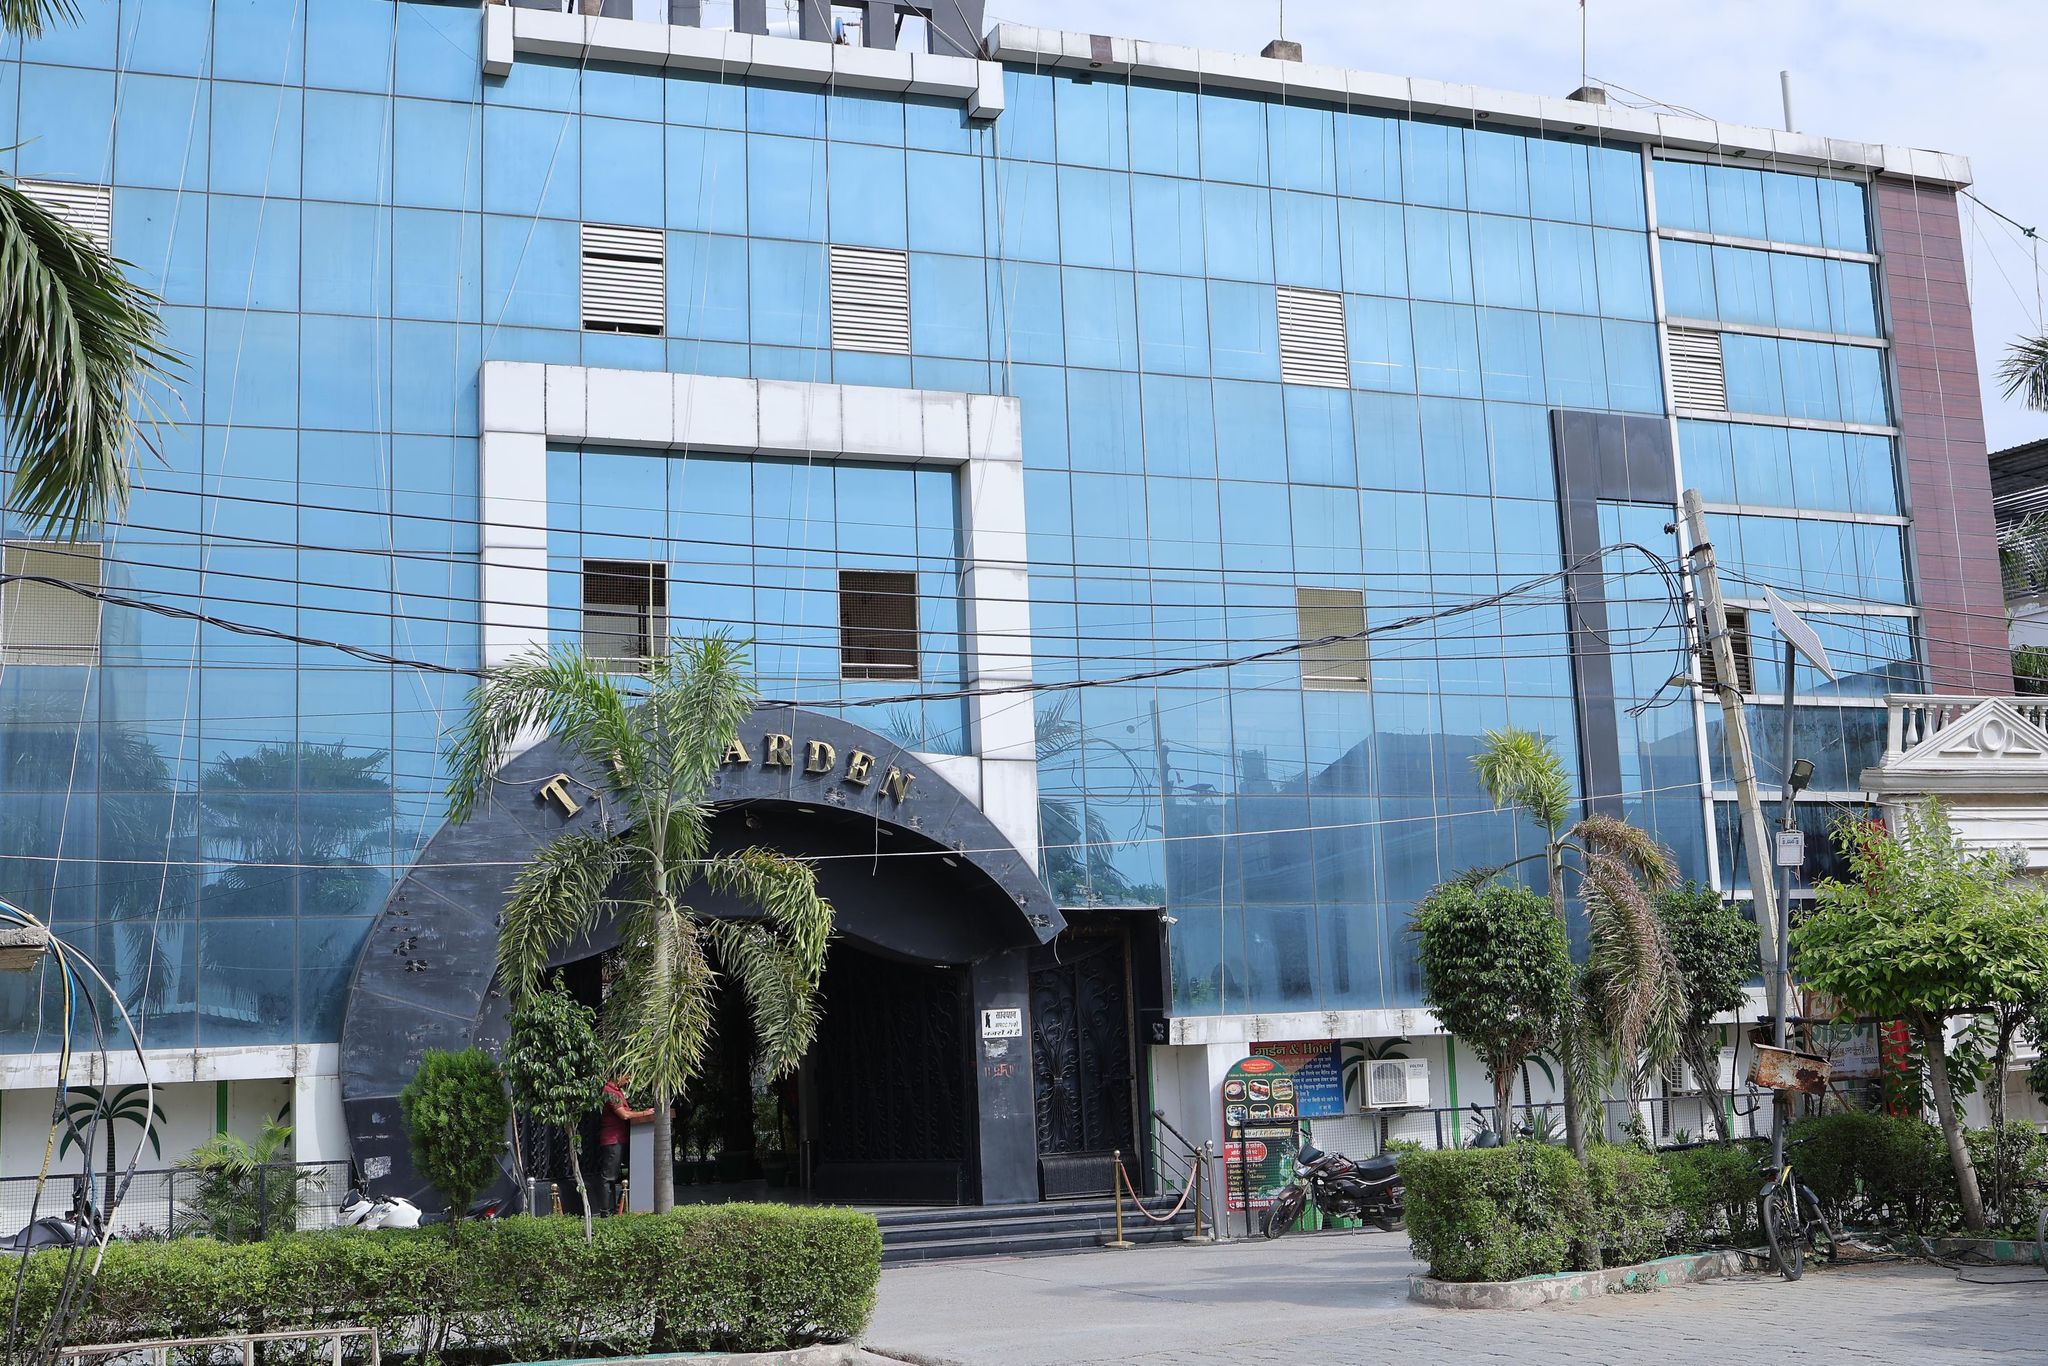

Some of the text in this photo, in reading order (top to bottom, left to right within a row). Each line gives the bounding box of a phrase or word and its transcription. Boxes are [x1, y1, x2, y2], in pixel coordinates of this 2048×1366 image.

[711, 733, 916, 804] ARDEN
[1289, 1043, 1299, 1055] &
[1304, 1042, 1332, 1054] Hotel
